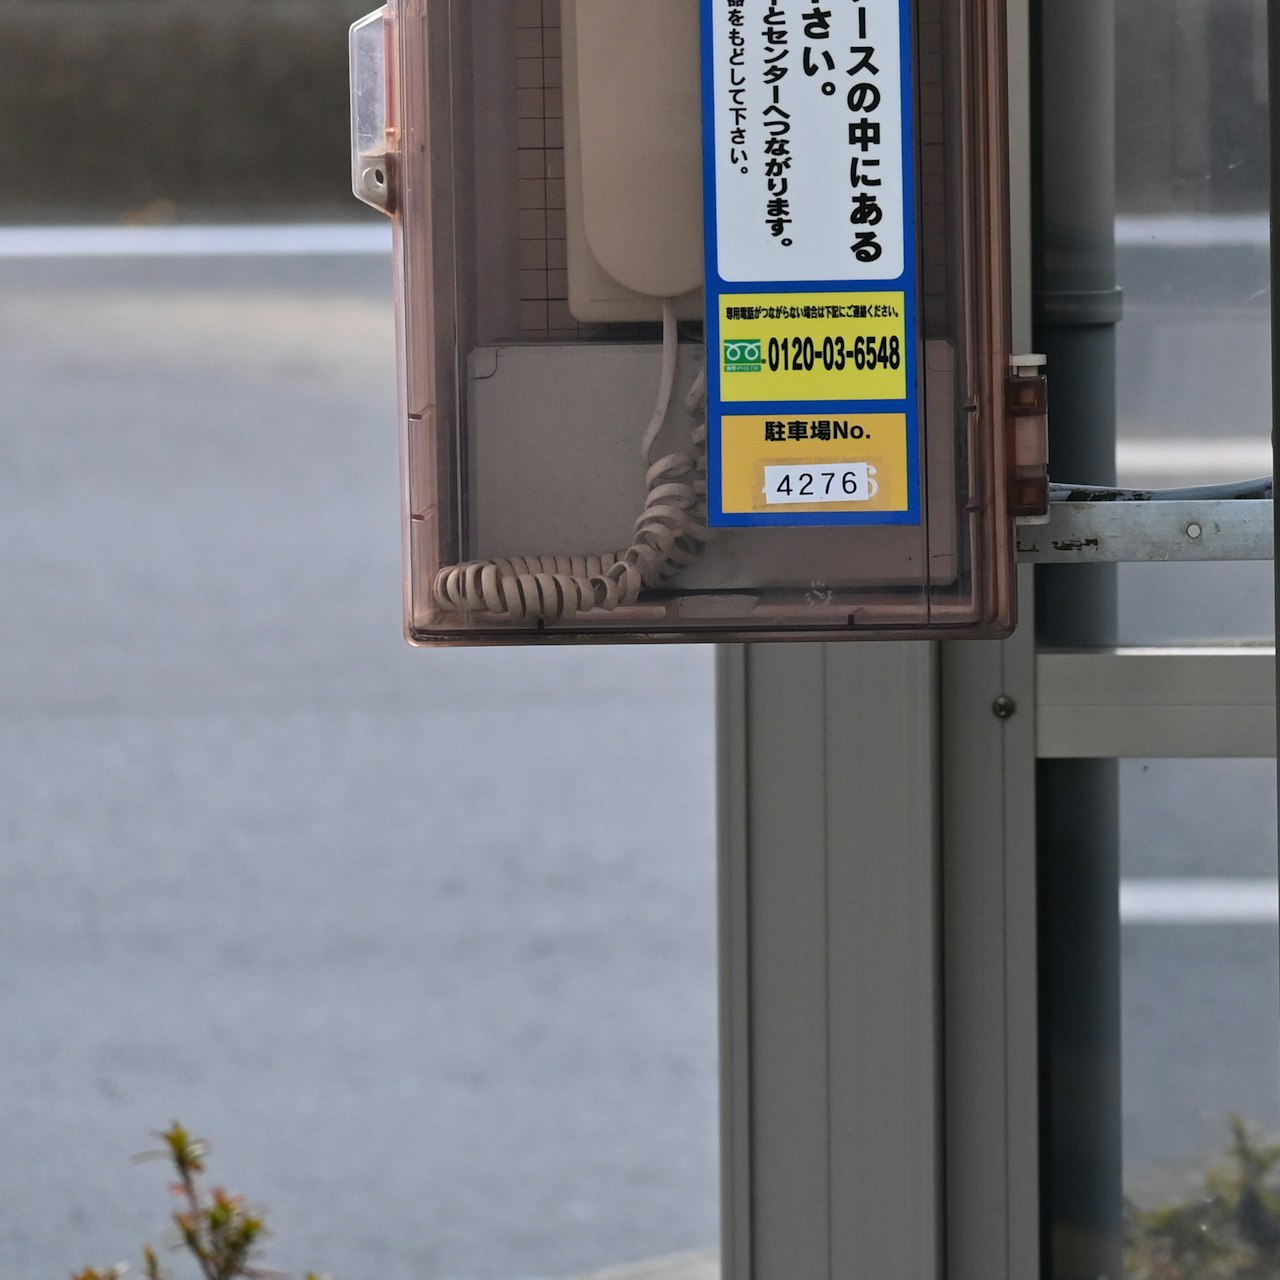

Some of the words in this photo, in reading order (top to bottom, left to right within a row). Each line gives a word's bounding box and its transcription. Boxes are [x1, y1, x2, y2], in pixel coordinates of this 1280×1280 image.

[768, 335, 900, 372] 0120-03-6548
[764, 420, 871, 442] 駐車場No.
[776, 471, 858, 497] 4276
